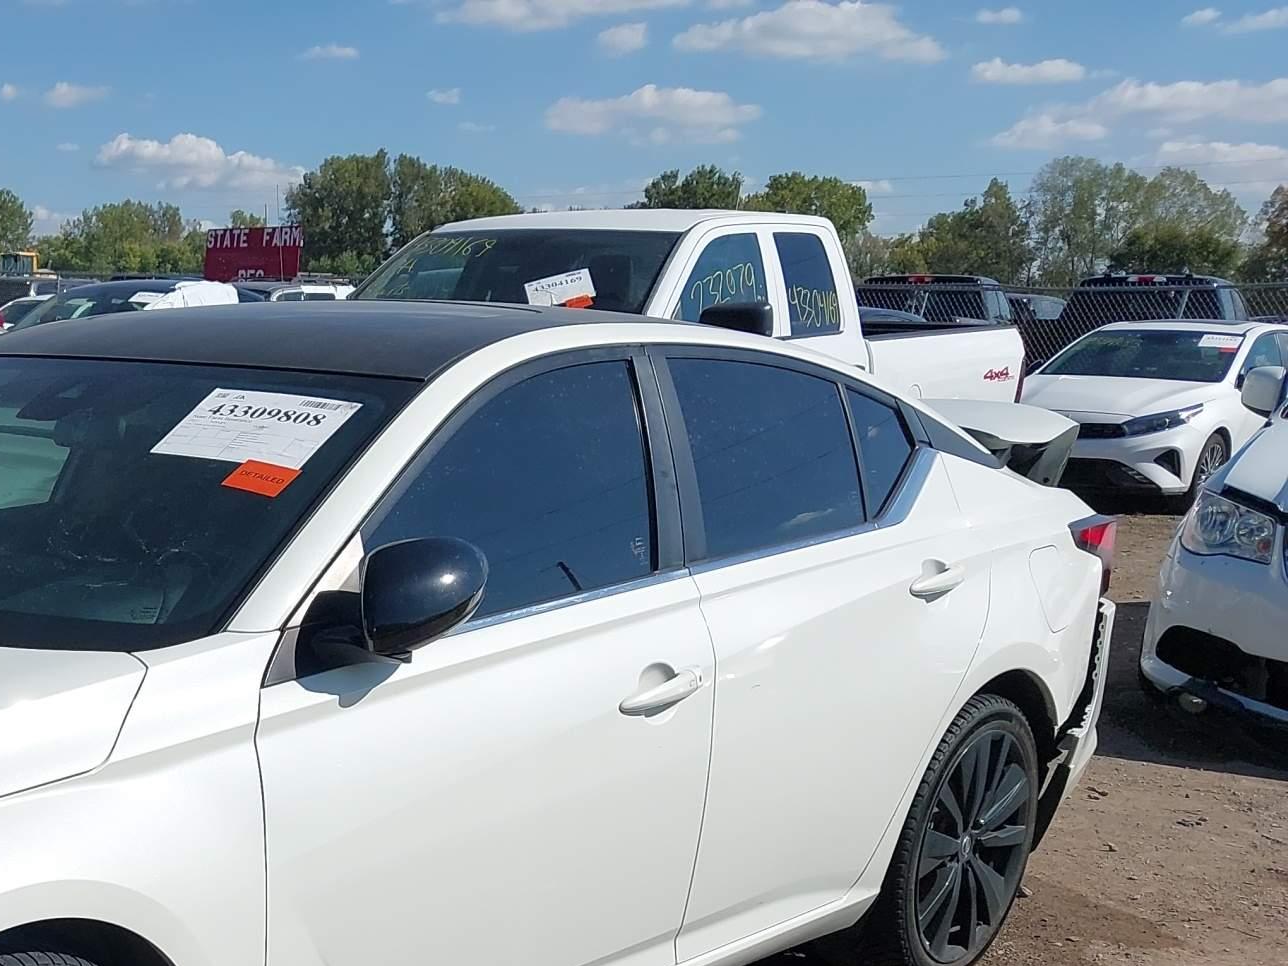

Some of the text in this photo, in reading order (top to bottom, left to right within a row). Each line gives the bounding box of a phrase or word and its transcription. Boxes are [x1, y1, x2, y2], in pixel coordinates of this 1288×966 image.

[207, 227, 303, 248] STATE FARM
[983, 366, 1009, 381] 4x4
[208, 403, 327, 428] 43309808
